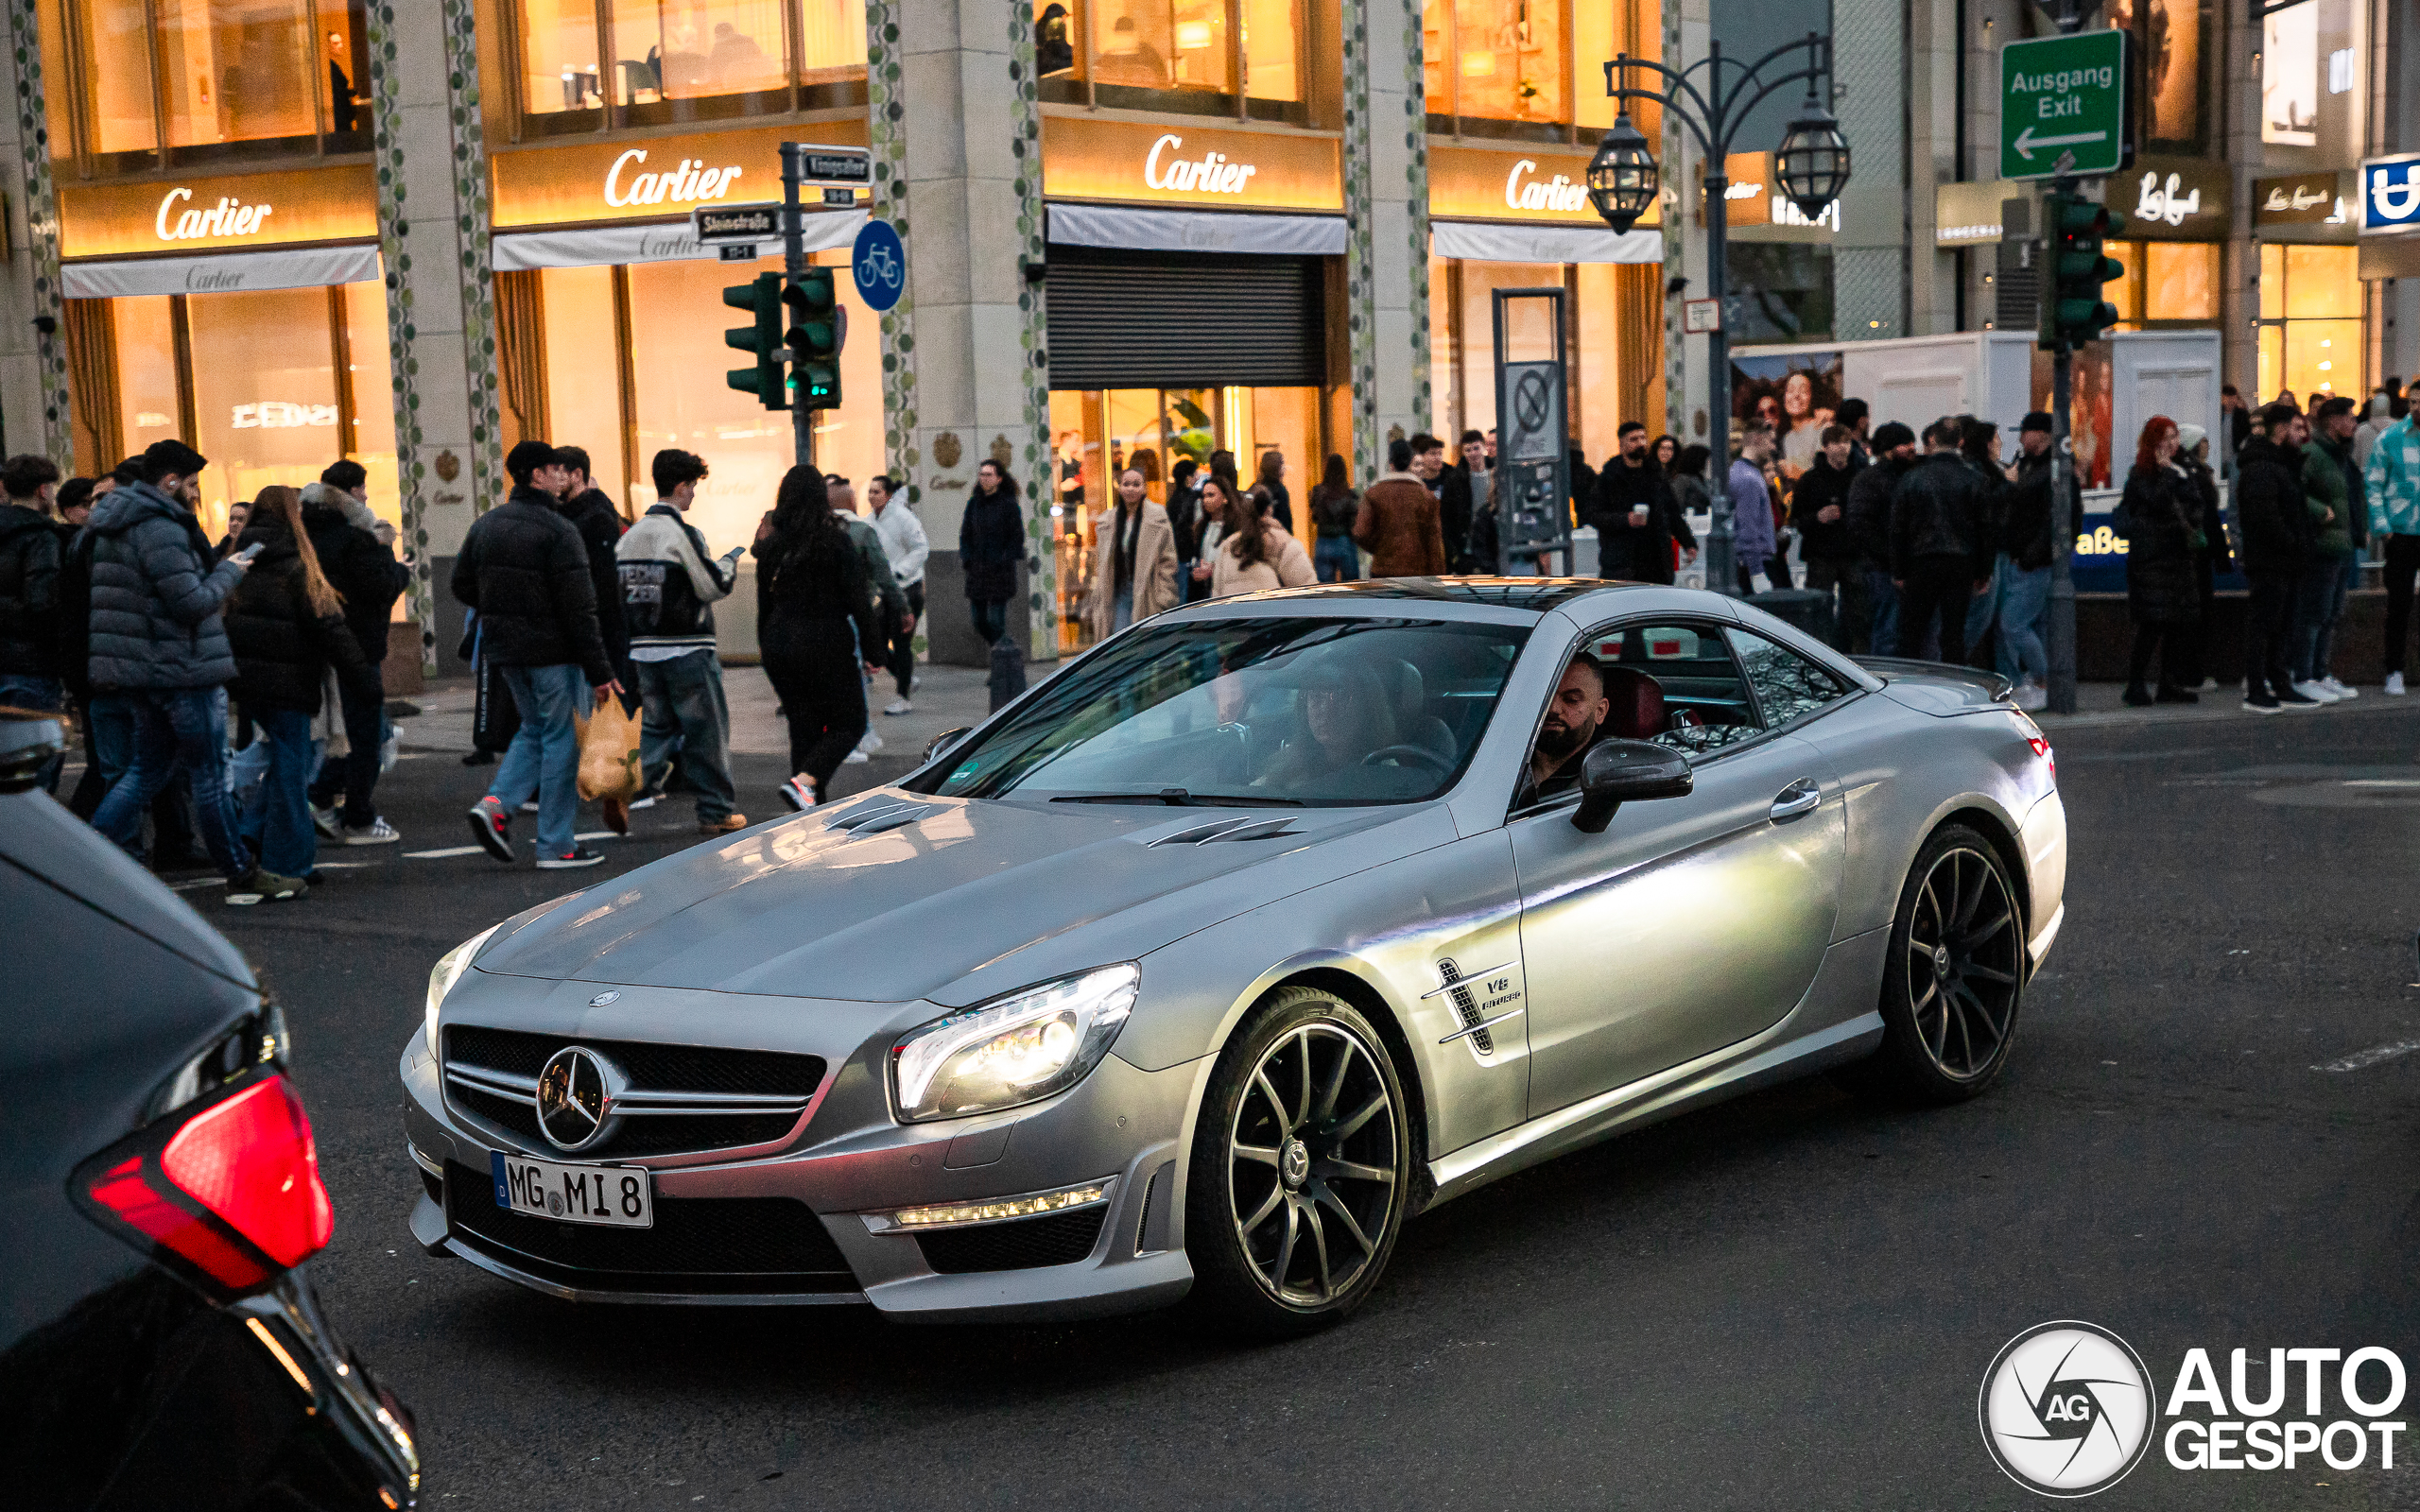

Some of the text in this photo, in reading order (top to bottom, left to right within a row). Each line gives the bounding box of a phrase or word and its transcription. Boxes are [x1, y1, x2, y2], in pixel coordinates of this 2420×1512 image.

[2010, 65, 2113, 94] Ausgang
[2037, 94, 2082, 119] Exit
[604, 148, 743, 208] Cartier
[1145, 133, 1256, 194] Cartier
[1506, 159, 1590, 212] Cartier
[155, 187, 272, 241] Cartier
[185, 264, 246, 290] Cartier
[1487, 976, 1510, 994] V8
[1481, 990, 1522, 1010] BITURBO
[499, 1185, 506, 1197] D
[507, 1161, 643, 1218] MG MI 8
